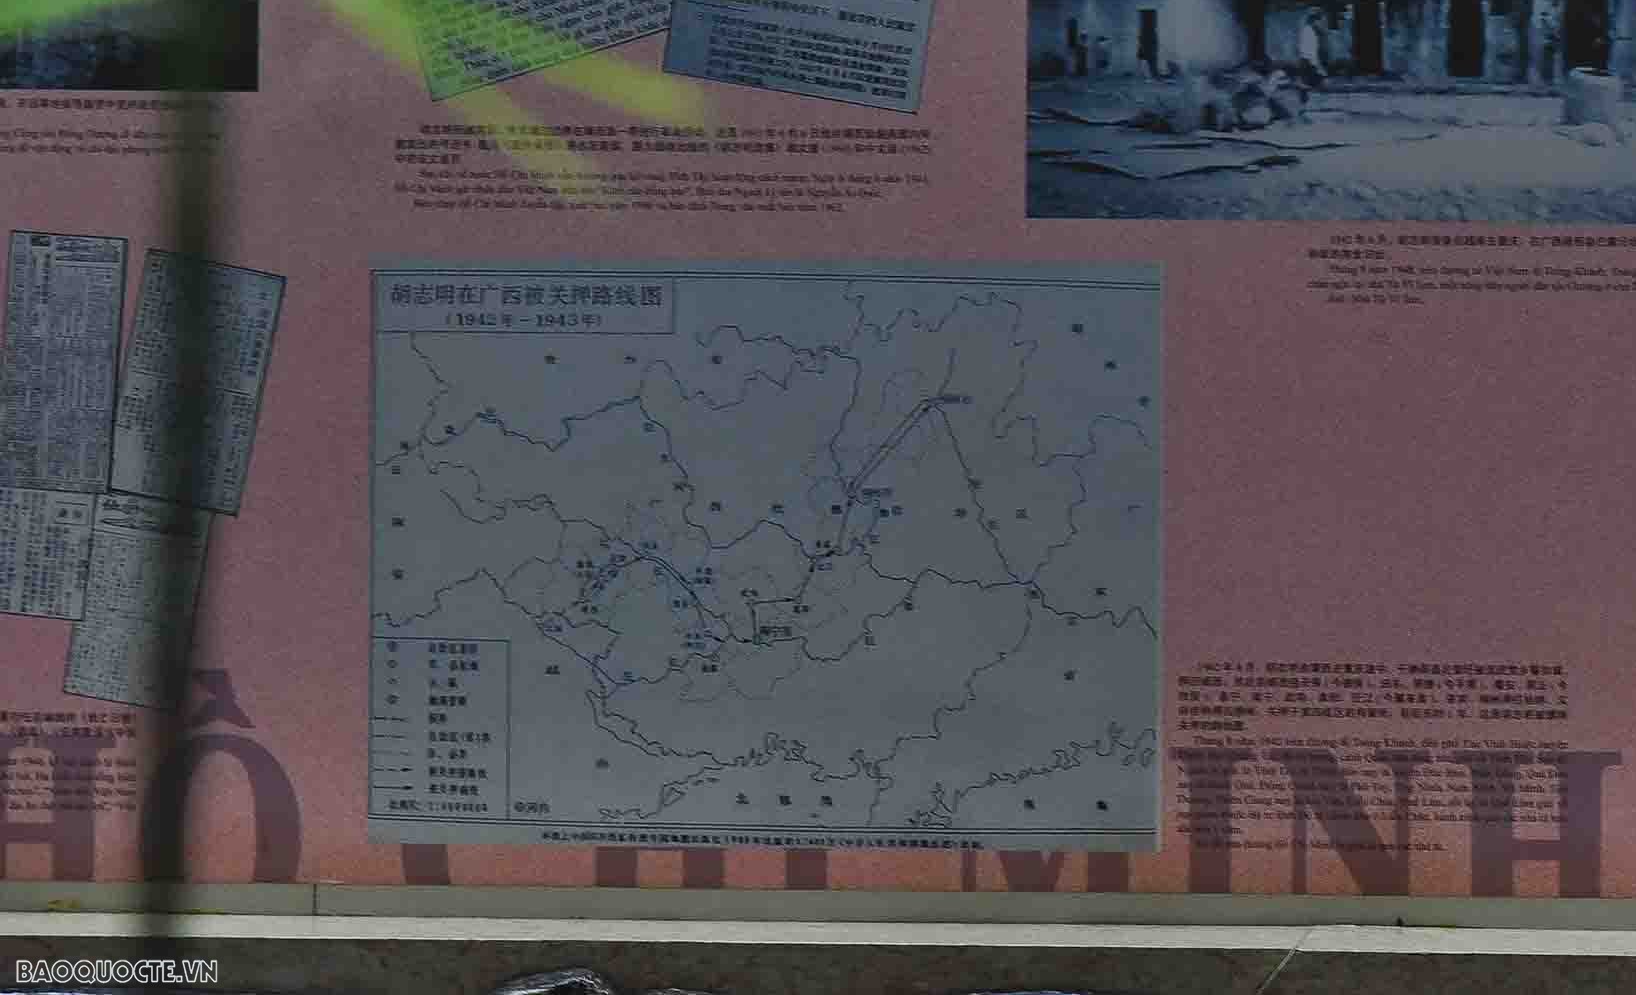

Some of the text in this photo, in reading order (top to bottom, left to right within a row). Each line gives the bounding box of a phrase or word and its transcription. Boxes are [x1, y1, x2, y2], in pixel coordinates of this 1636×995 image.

[390, 283, 663, 307] 胡志明在广西被关押路线图
